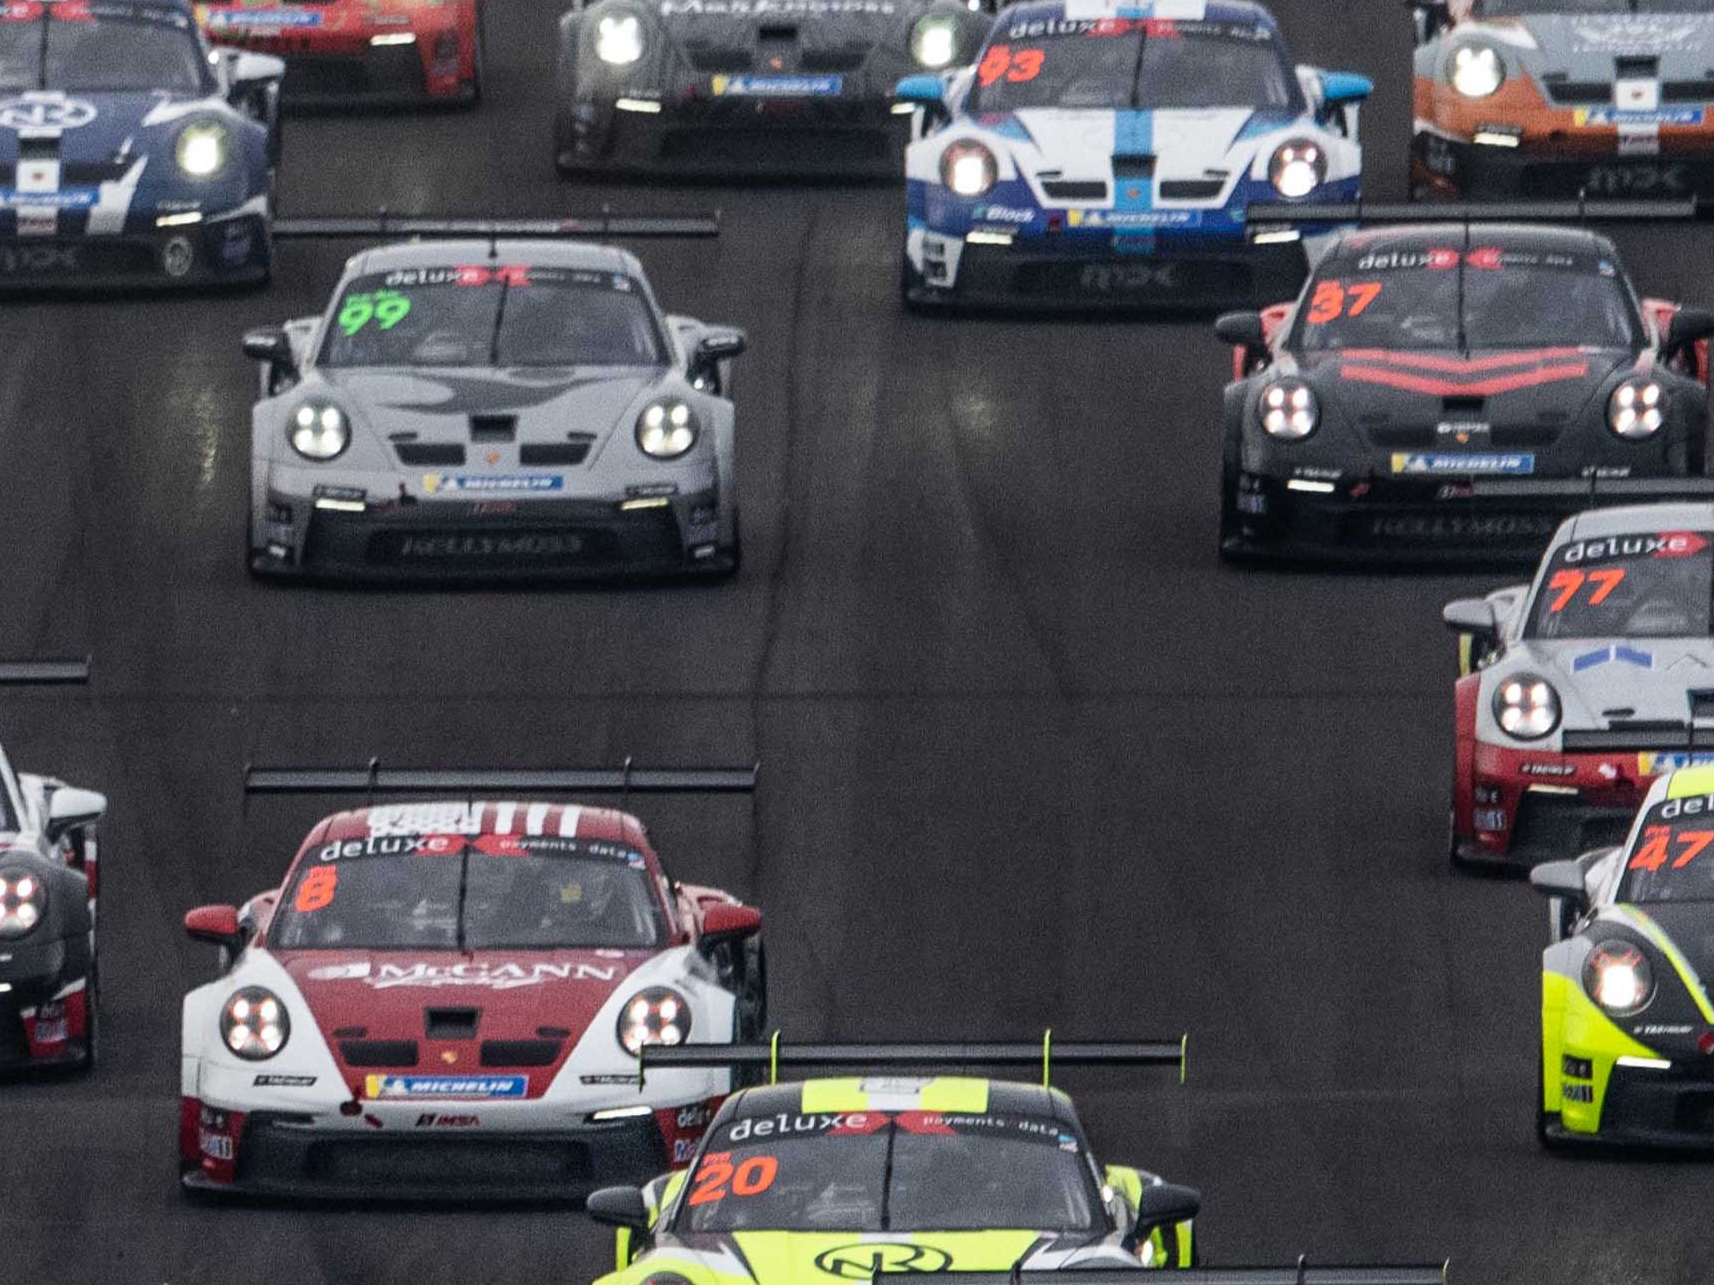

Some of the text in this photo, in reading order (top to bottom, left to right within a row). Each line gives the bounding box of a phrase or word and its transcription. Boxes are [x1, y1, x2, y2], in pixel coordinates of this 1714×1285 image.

[1009, 19, 1115, 39] deluxe
[1358, 250, 1450, 271] deluxe
[385, 270, 477, 287] deluxe
[338, 294, 411, 336] 99
[1564, 537, 1688, 563] deluxe
[1548, 569, 1626, 613] 77
[320, 837, 448, 862] deluxe
[295, 872, 337, 912] 8
[411, 1078, 515, 1094] MICHELIN
[729, 1114, 1059, 1141] deluxe payments data
[688, 1156, 778, 1206] 20
